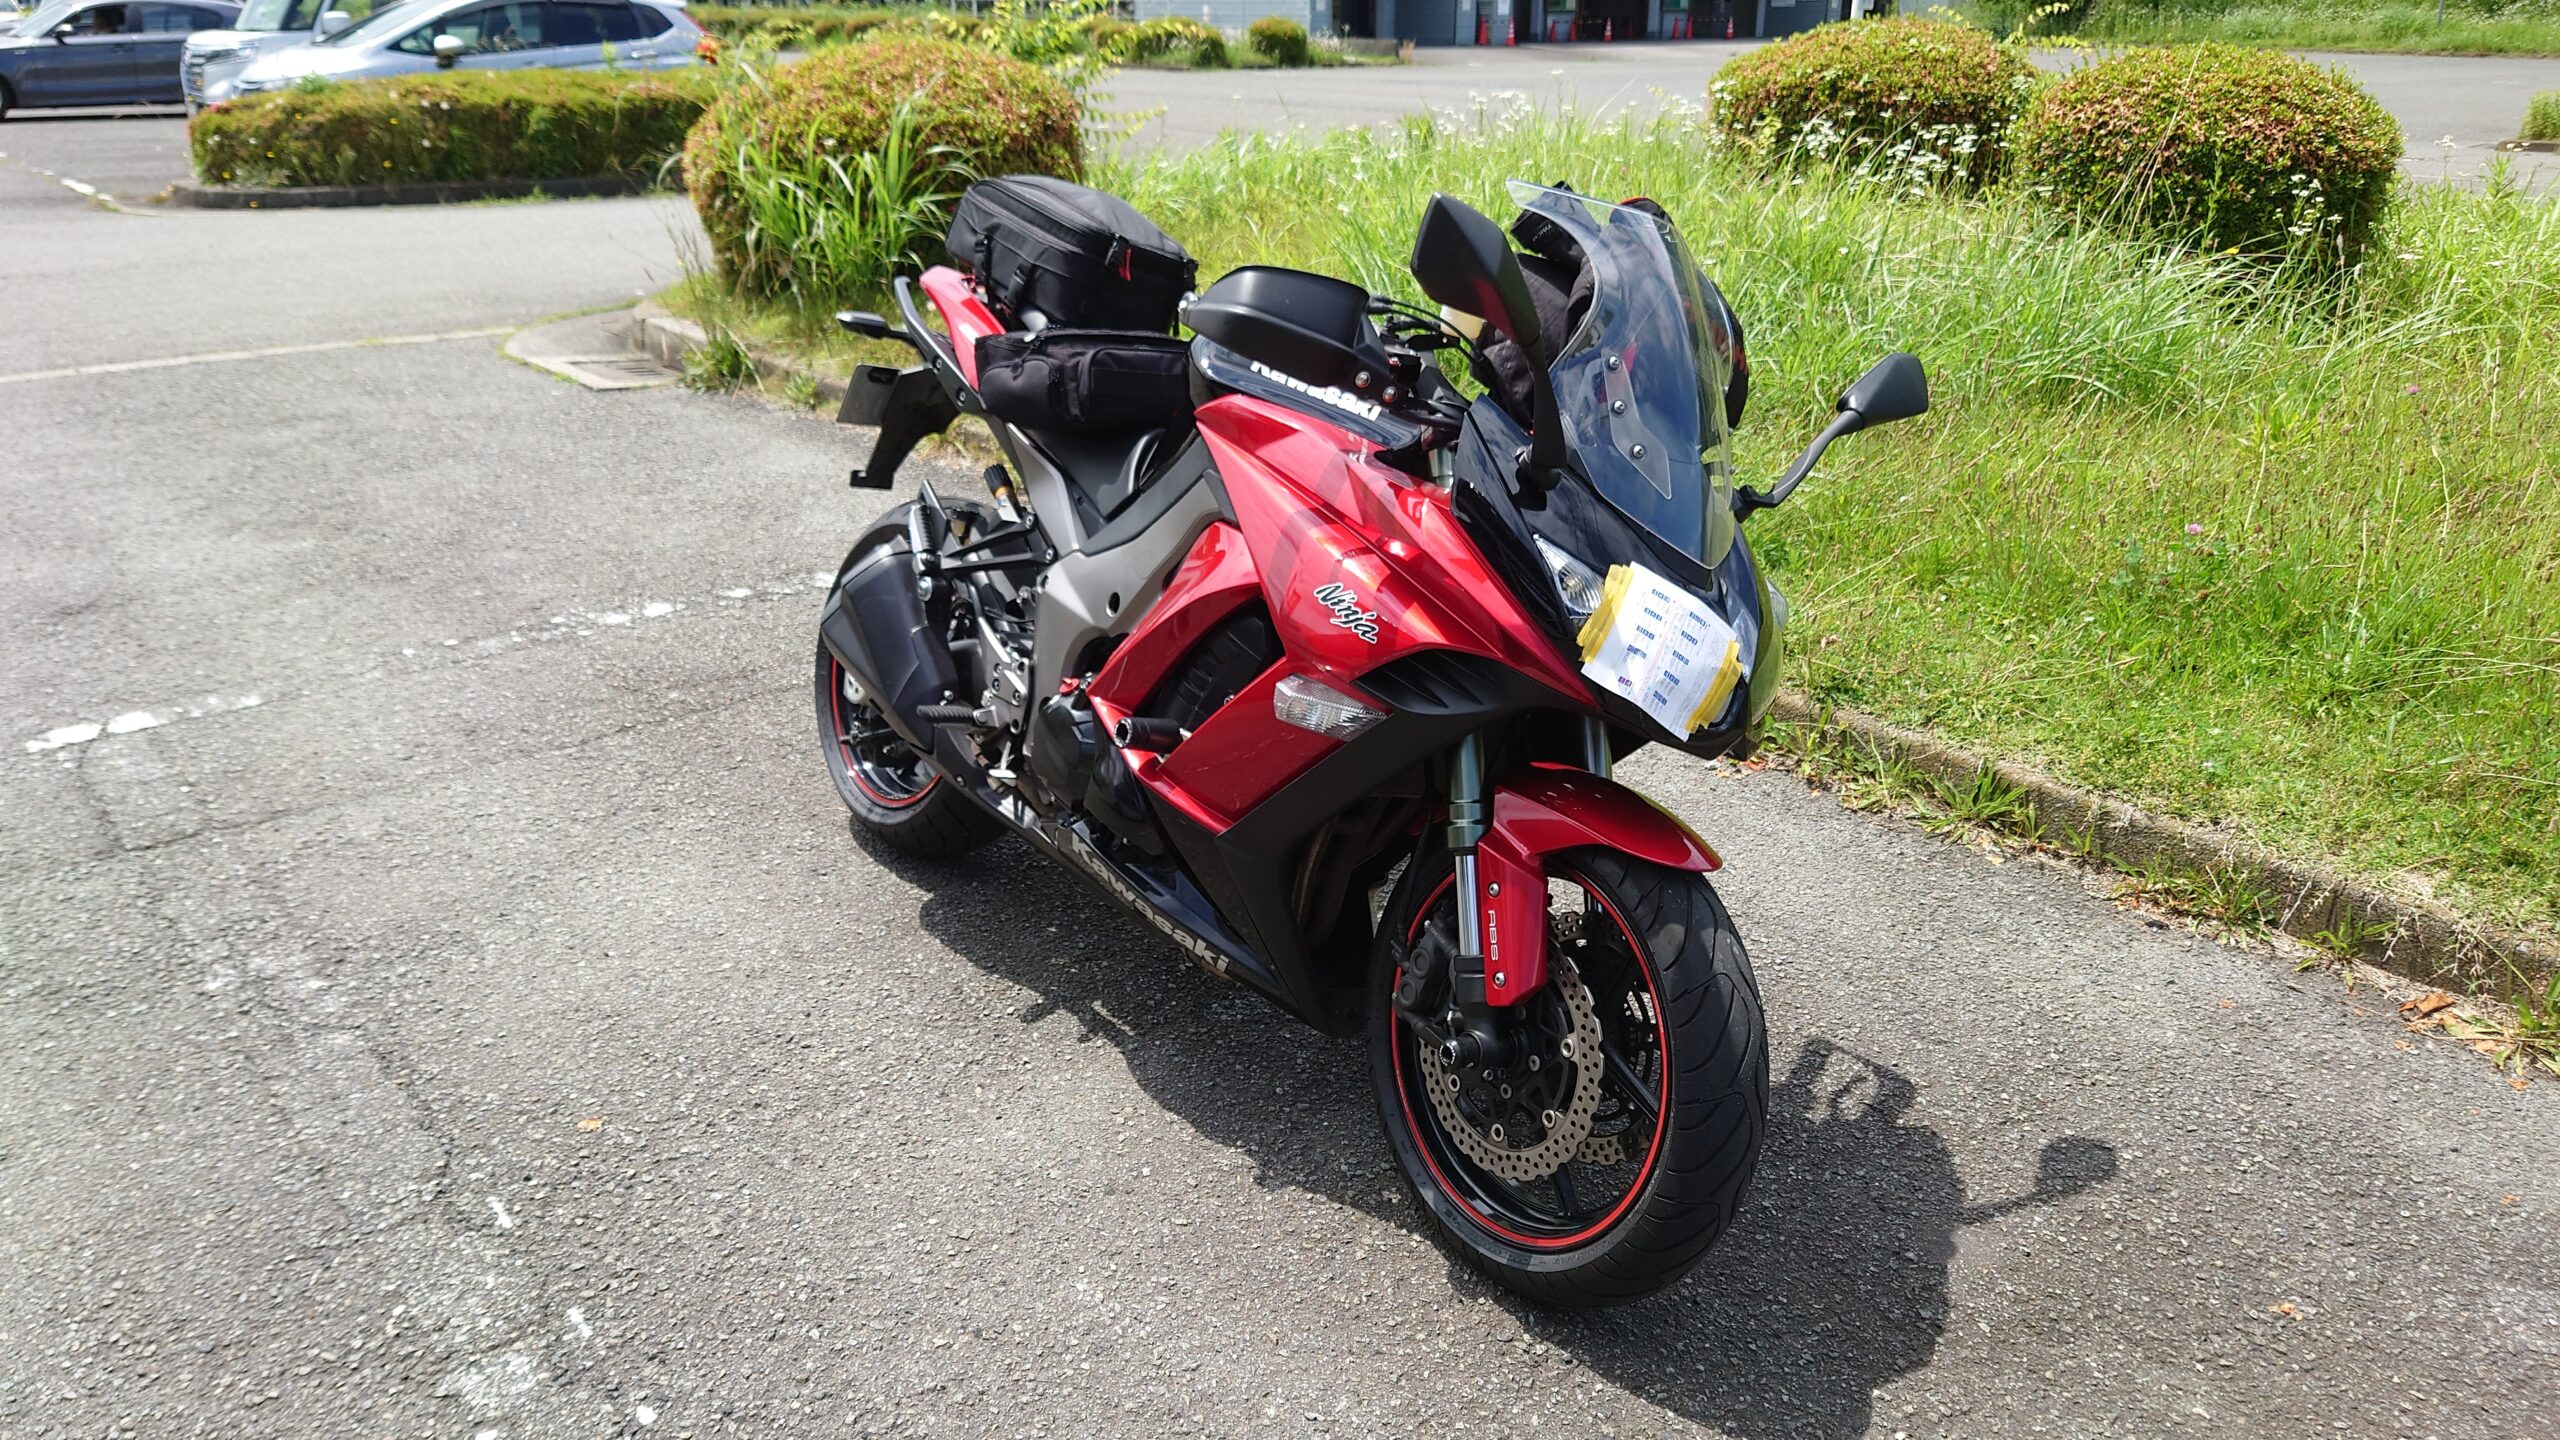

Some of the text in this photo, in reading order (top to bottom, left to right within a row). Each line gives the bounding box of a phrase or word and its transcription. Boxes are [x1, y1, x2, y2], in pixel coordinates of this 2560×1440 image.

[1313, 582, 1379, 644] Ninja
[1072, 832, 1230, 973] Kawasaki
[1487, 909, 1499, 961] ABS
